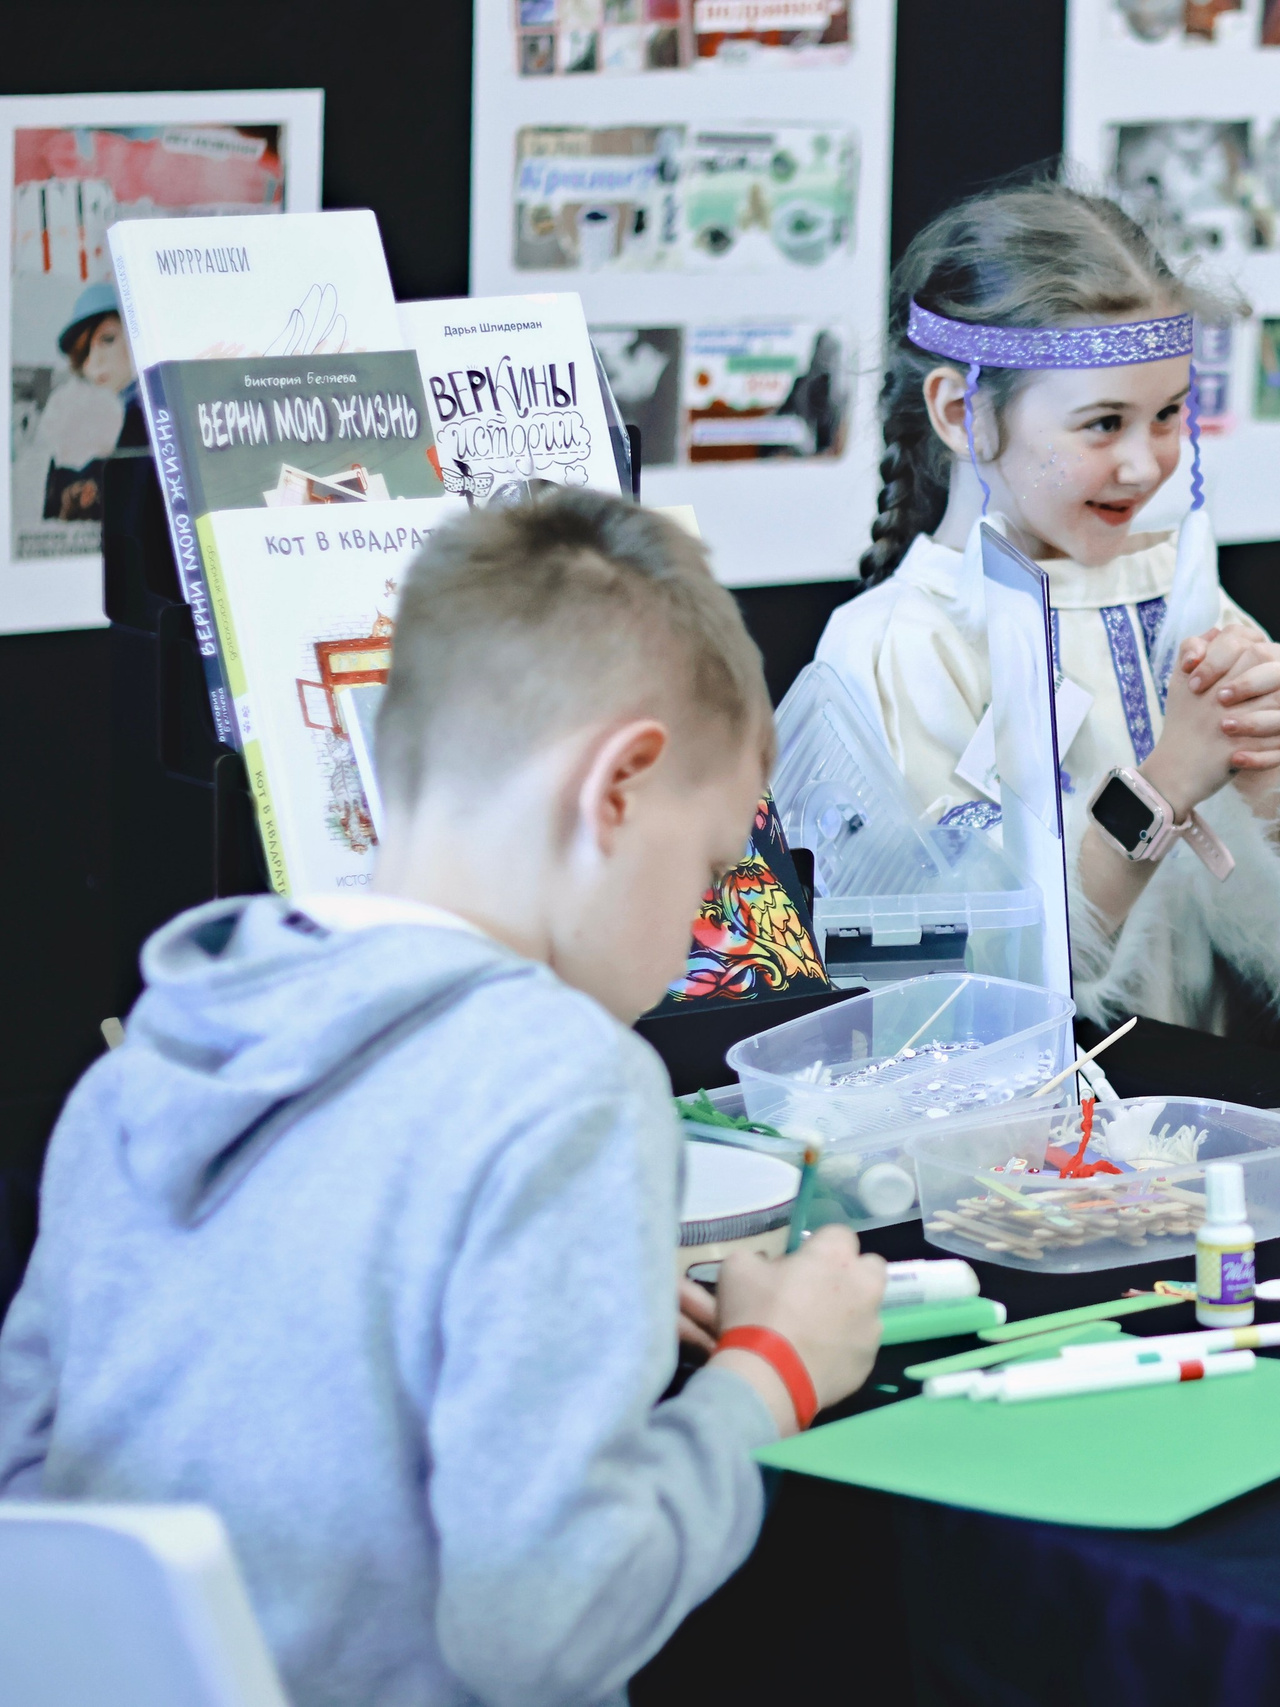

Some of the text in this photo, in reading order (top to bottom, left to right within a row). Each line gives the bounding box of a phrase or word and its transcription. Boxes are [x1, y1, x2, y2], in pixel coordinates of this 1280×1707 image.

[156, 247, 250, 275] МУРРРАШКИ
[444, 320, 542, 337] Дарья Шлидерман
[244, 371, 357, 389] Виктория Беляева
[429, 355, 577, 422] ВЕРКИНЫ
[198, 393, 418, 448] ВЕРНИ МОЮ ЖИЗНЬ
[452, 416, 580, 476] истории
[156, 409, 215, 656] ВЕРНИ МОЮ ЖИЗНЬ
[265, 535, 305, 556] КОТ
[316, 531, 330, 551] В
[255, 770, 266, 798] КОТ
[263, 805, 271, 814] В
